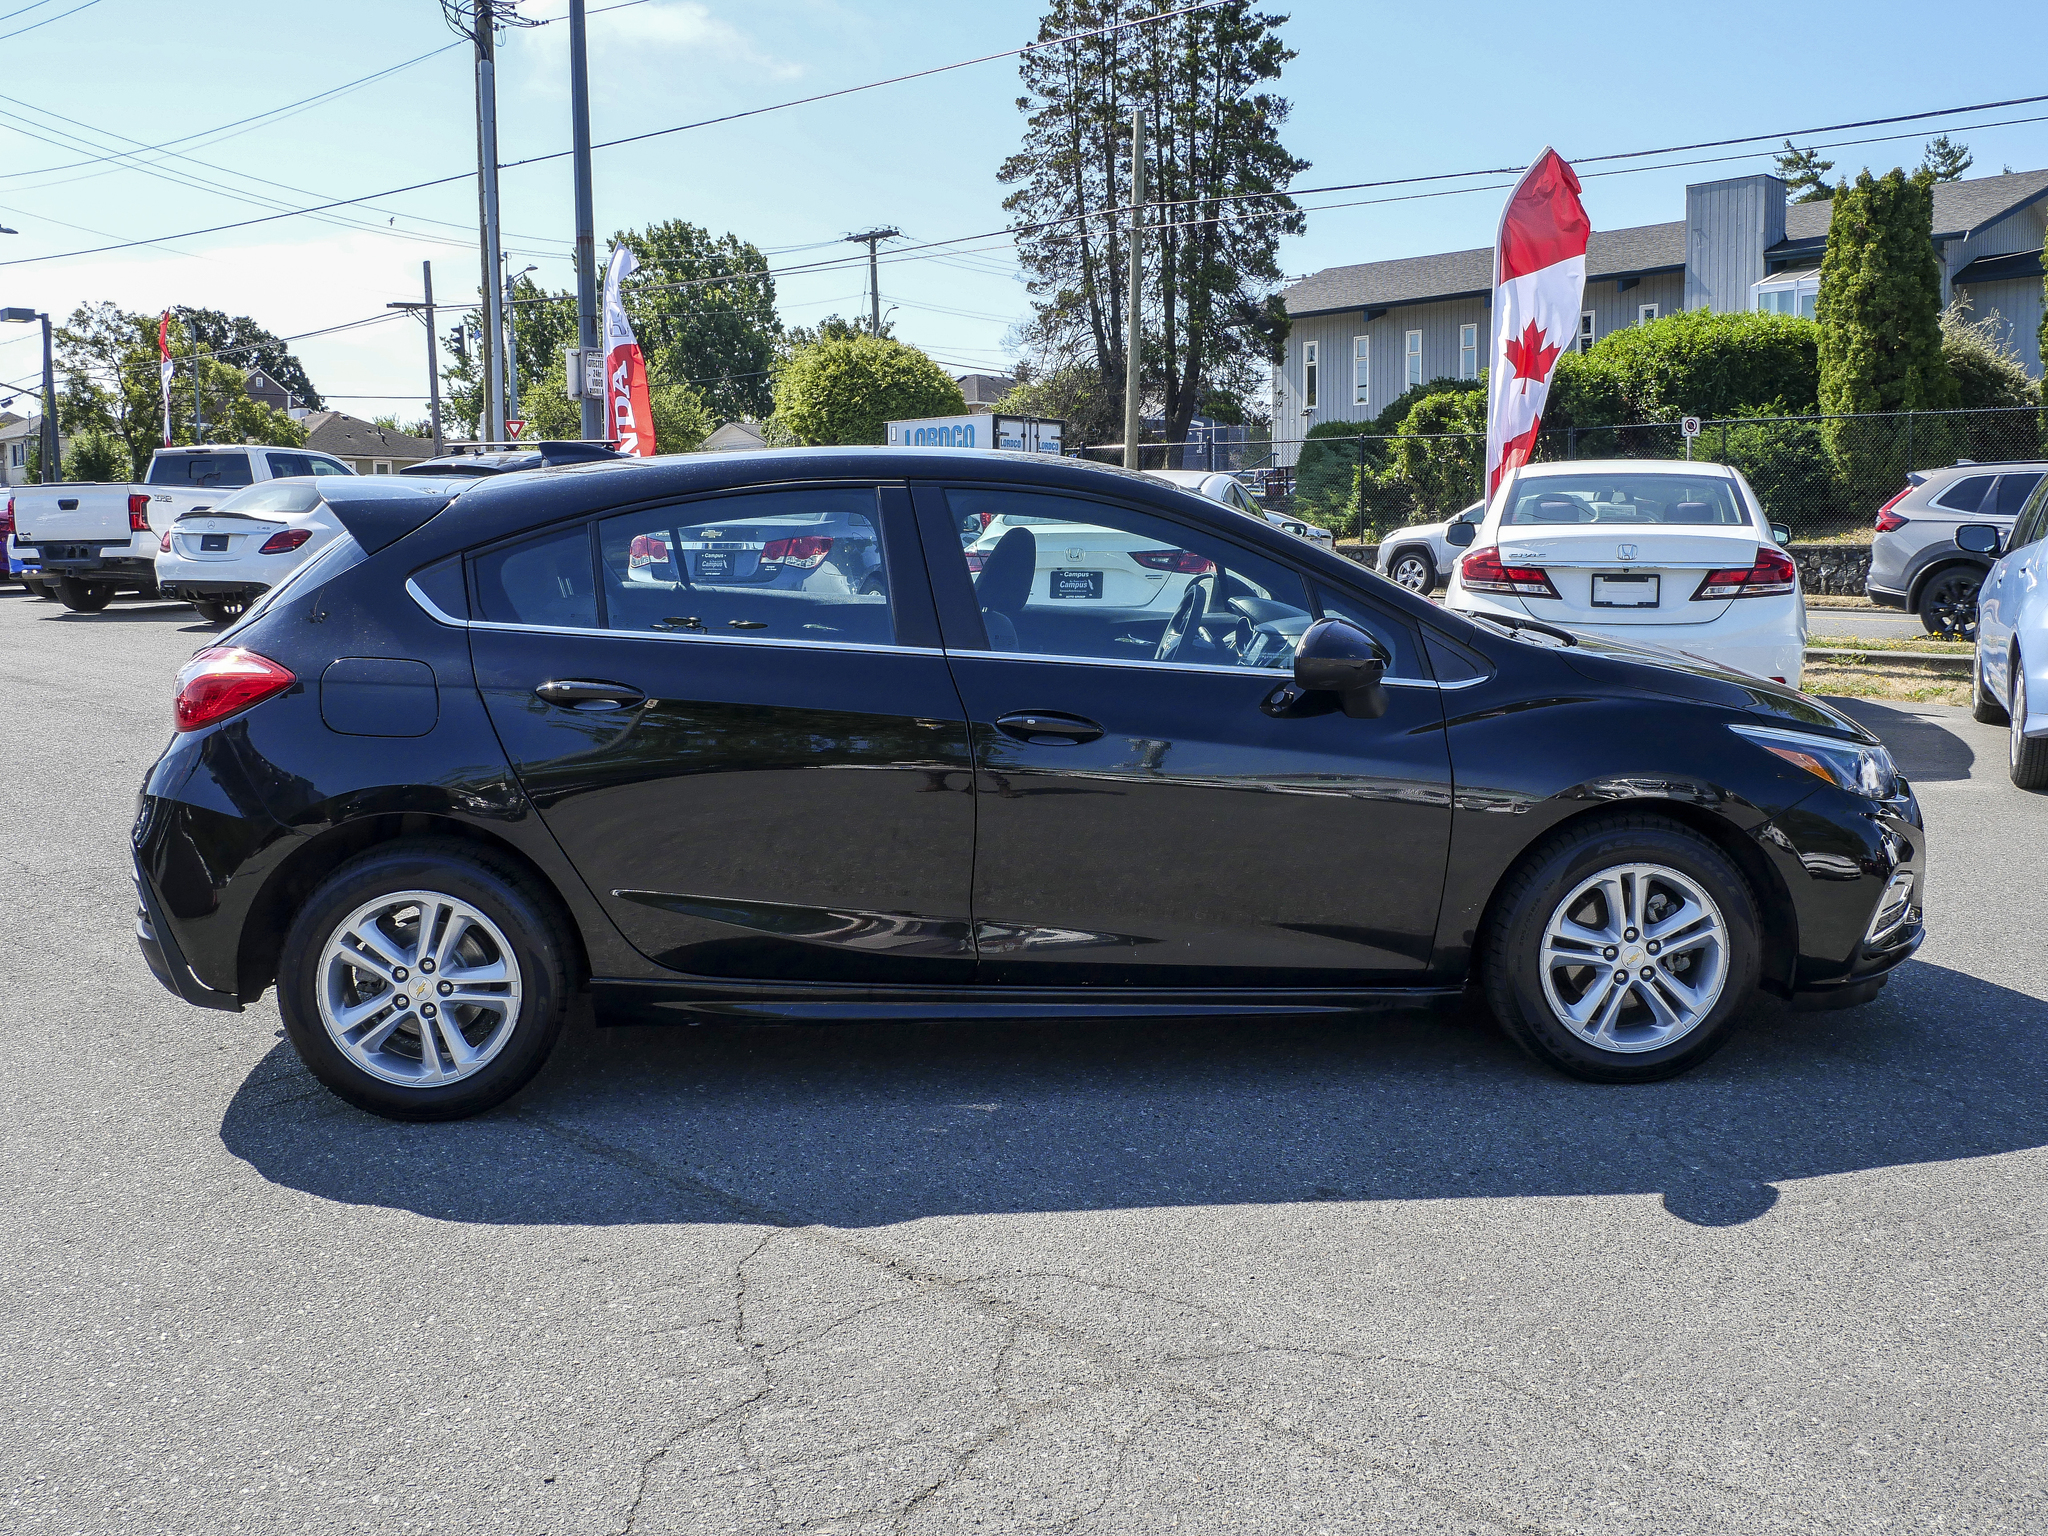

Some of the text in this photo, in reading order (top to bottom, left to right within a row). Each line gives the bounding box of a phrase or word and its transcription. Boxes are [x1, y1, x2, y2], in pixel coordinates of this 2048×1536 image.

[612, 360, 641, 458] NDA
[1000, 438, 1022, 448] LORDCO
[1038, 441, 1059, 451] LORDCO
[1059, 580, 1088, 590] Campus
